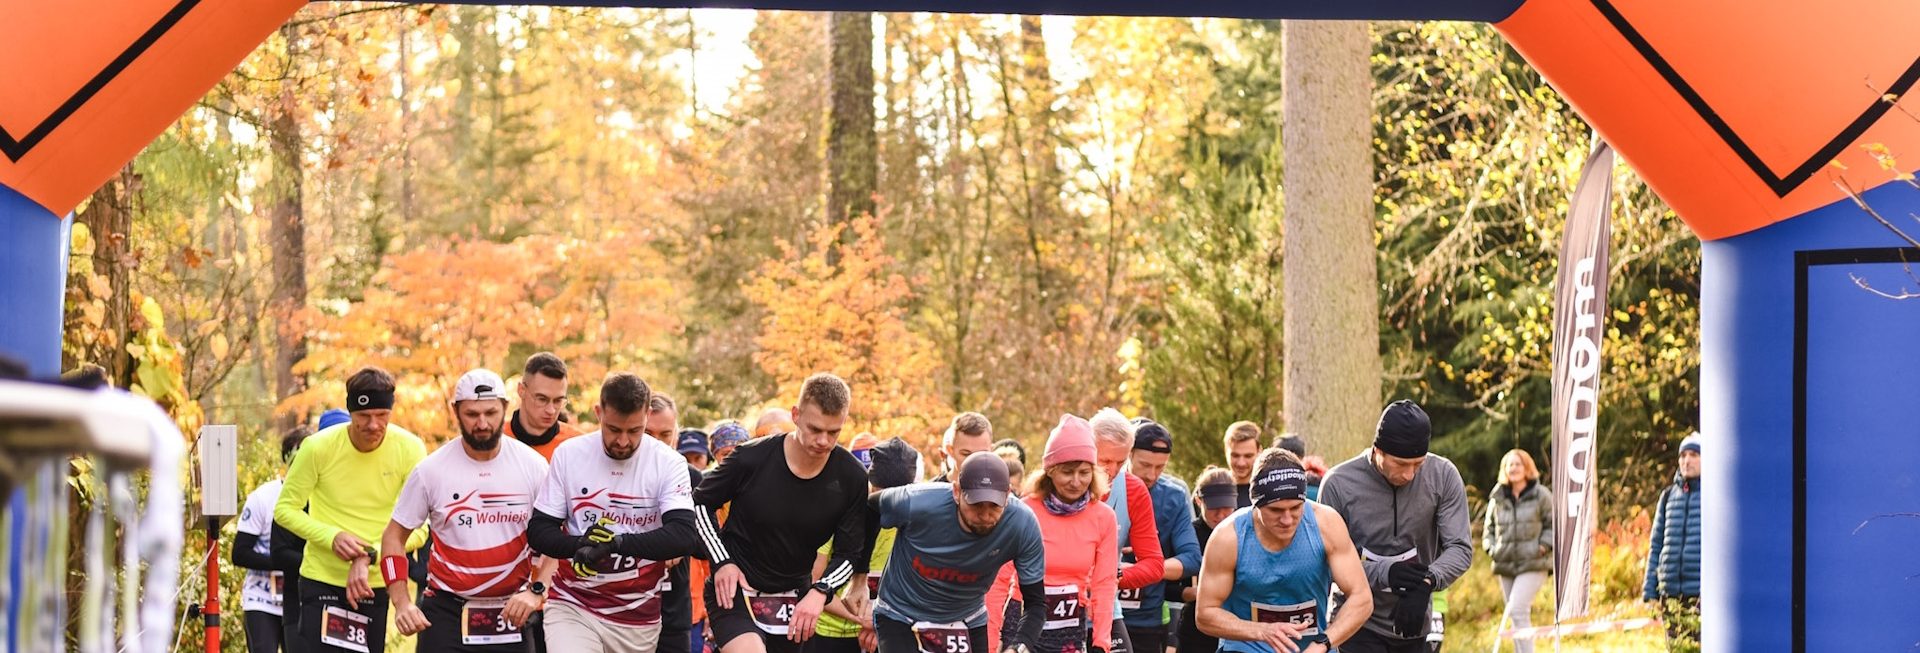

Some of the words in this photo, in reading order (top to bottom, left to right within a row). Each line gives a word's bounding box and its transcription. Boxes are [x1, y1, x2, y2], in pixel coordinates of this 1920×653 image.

[458, 514, 473, 528] Są
[1053, 599, 1078, 617] 47
[347, 625, 366, 644] 38
[946, 635, 970, 653] 55
